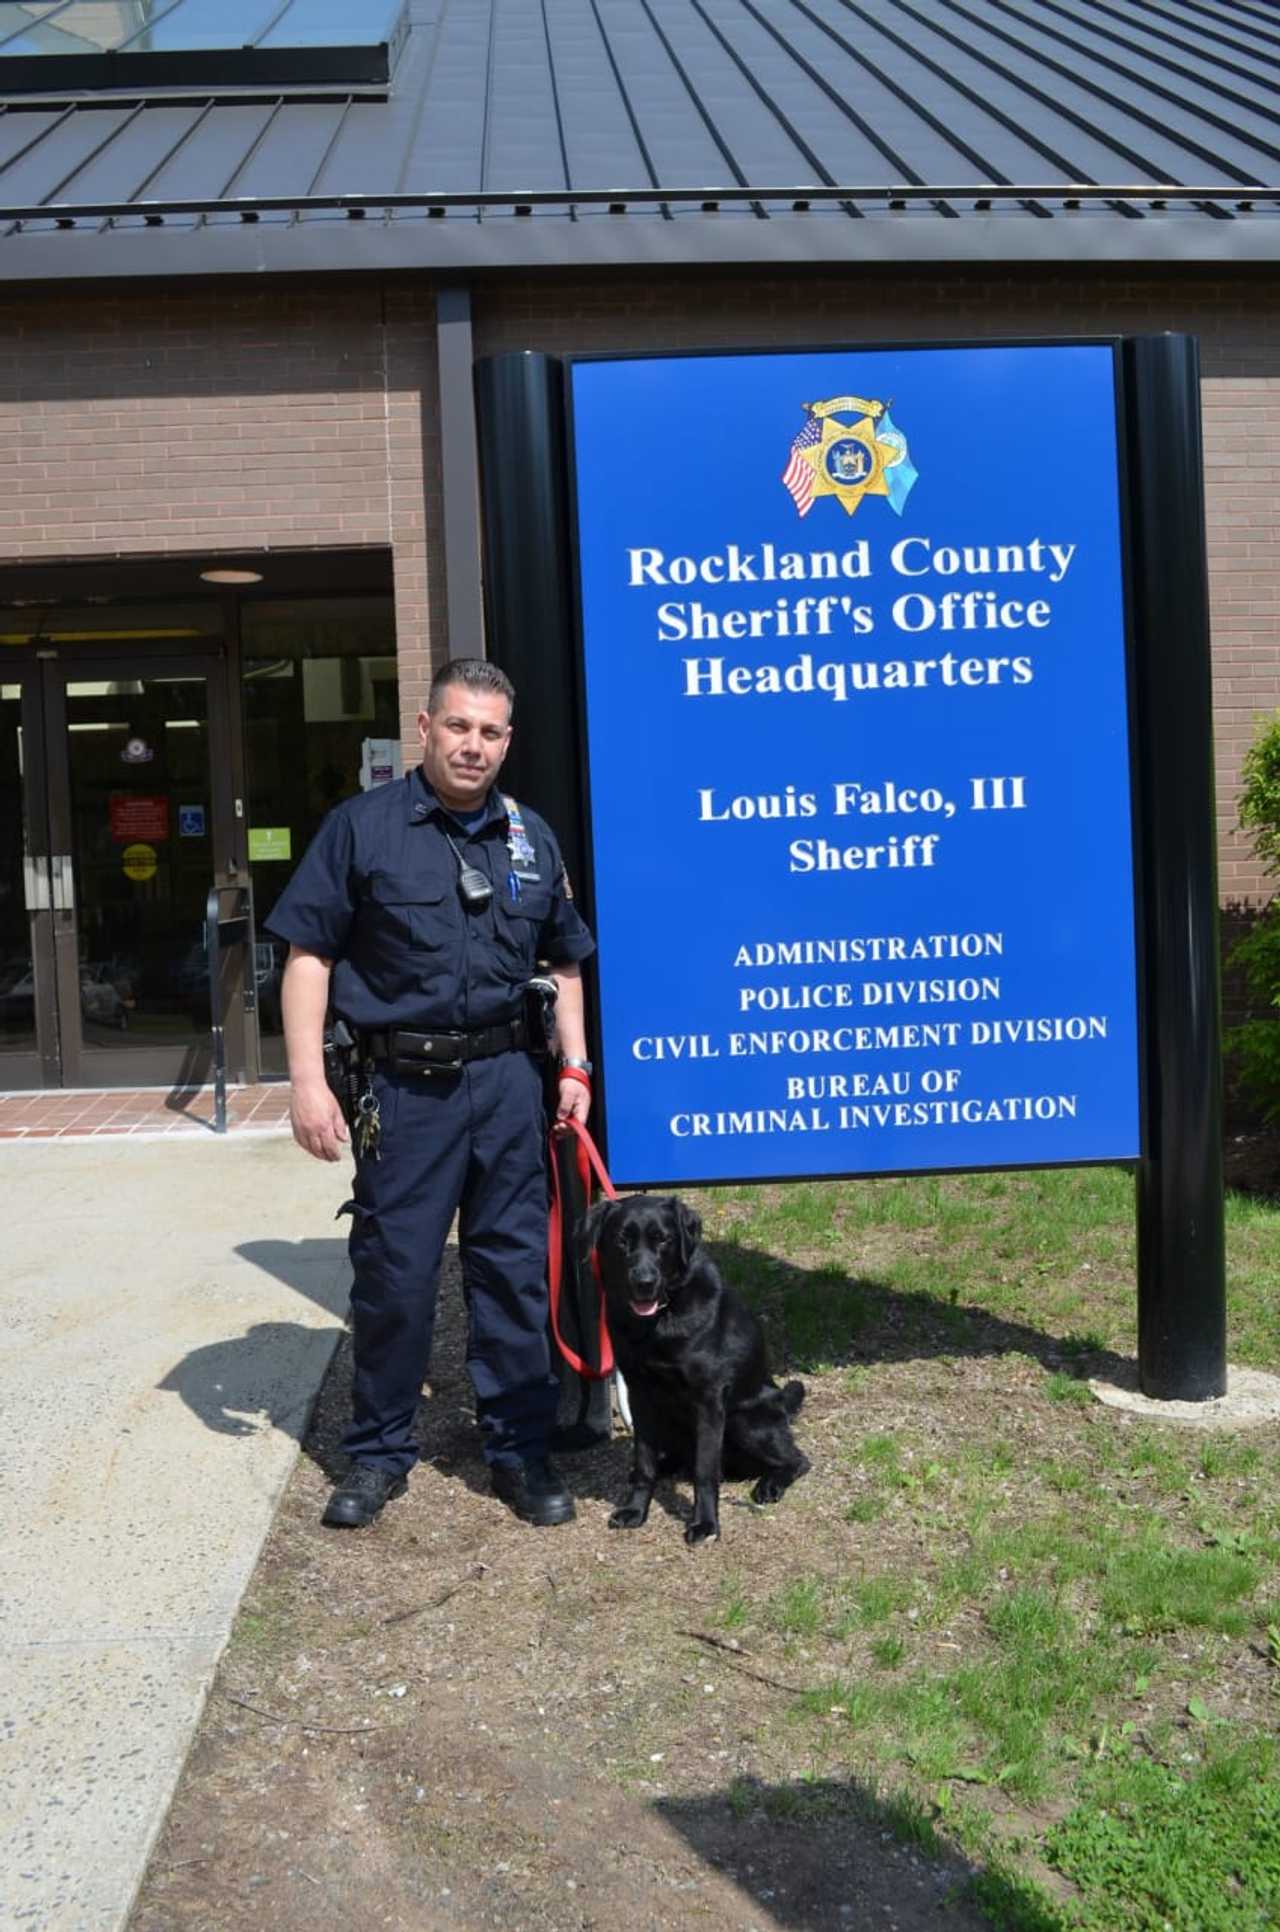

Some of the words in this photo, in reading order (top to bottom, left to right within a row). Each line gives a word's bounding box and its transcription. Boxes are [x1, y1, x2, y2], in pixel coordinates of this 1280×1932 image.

[628, 541, 872, 586] Rockland
[891, 537, 1076, 582] County
[657, 597, 874, 640] Sheriff's
[891, 592, 1051, 632] Office
[683, 653, 1033, 701] Headquarters
[699, 786, 817, 821] Louis
[834, 782, 956, 817] Falco,
[971, 777, 1026, 809] III
[790, 835, 940, 872] Sheriff
[734, 934, 1003, 967] ADMINISTRATION
[740, 984, 853, 1011] POLICE
[863, 978, 1000, 1005] DIVISION
[632, 1034, 719, 1060] CIVIL
[729, 1023, 962, 1056] ENFORCEMENT
[971, 1016, 1107, 1044] DIVISION
[787, 1071, 910, 1100] BUREAU
[921, 1069, 961, 1093] OF
[669, 1108, 830, 1137] CRIMINAL
[839, 1095, 1076, 1129] INVESTIGATION
